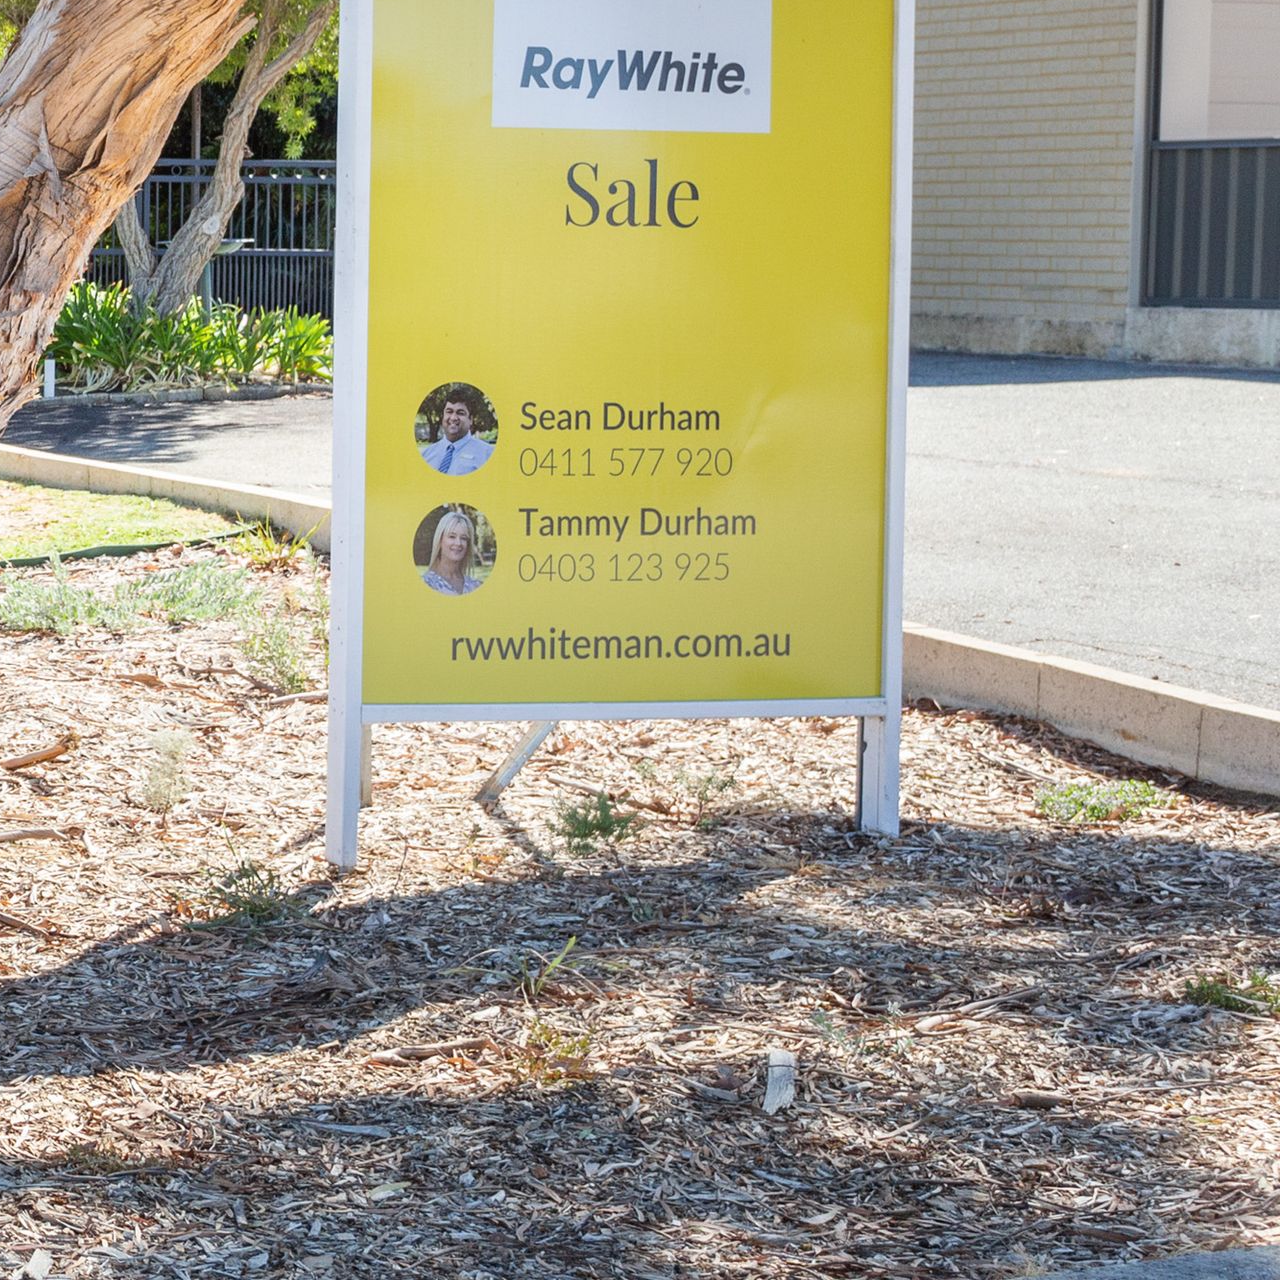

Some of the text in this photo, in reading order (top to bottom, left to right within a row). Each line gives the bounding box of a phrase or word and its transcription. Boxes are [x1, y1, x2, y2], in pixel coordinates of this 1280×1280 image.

[520, 46, 750, 99] RayWhite
[565, 158, 700, 229] Sale
[520, 401, 720, 431] Sean Durham
[519, 447, 733, 477] 0411 577 920
[518, 506, 757, 543] Tammy Durham
[518, 552, 730, 583] 0403 123 925
[450, 626, 792, 662] rwwhiteman.com.au
